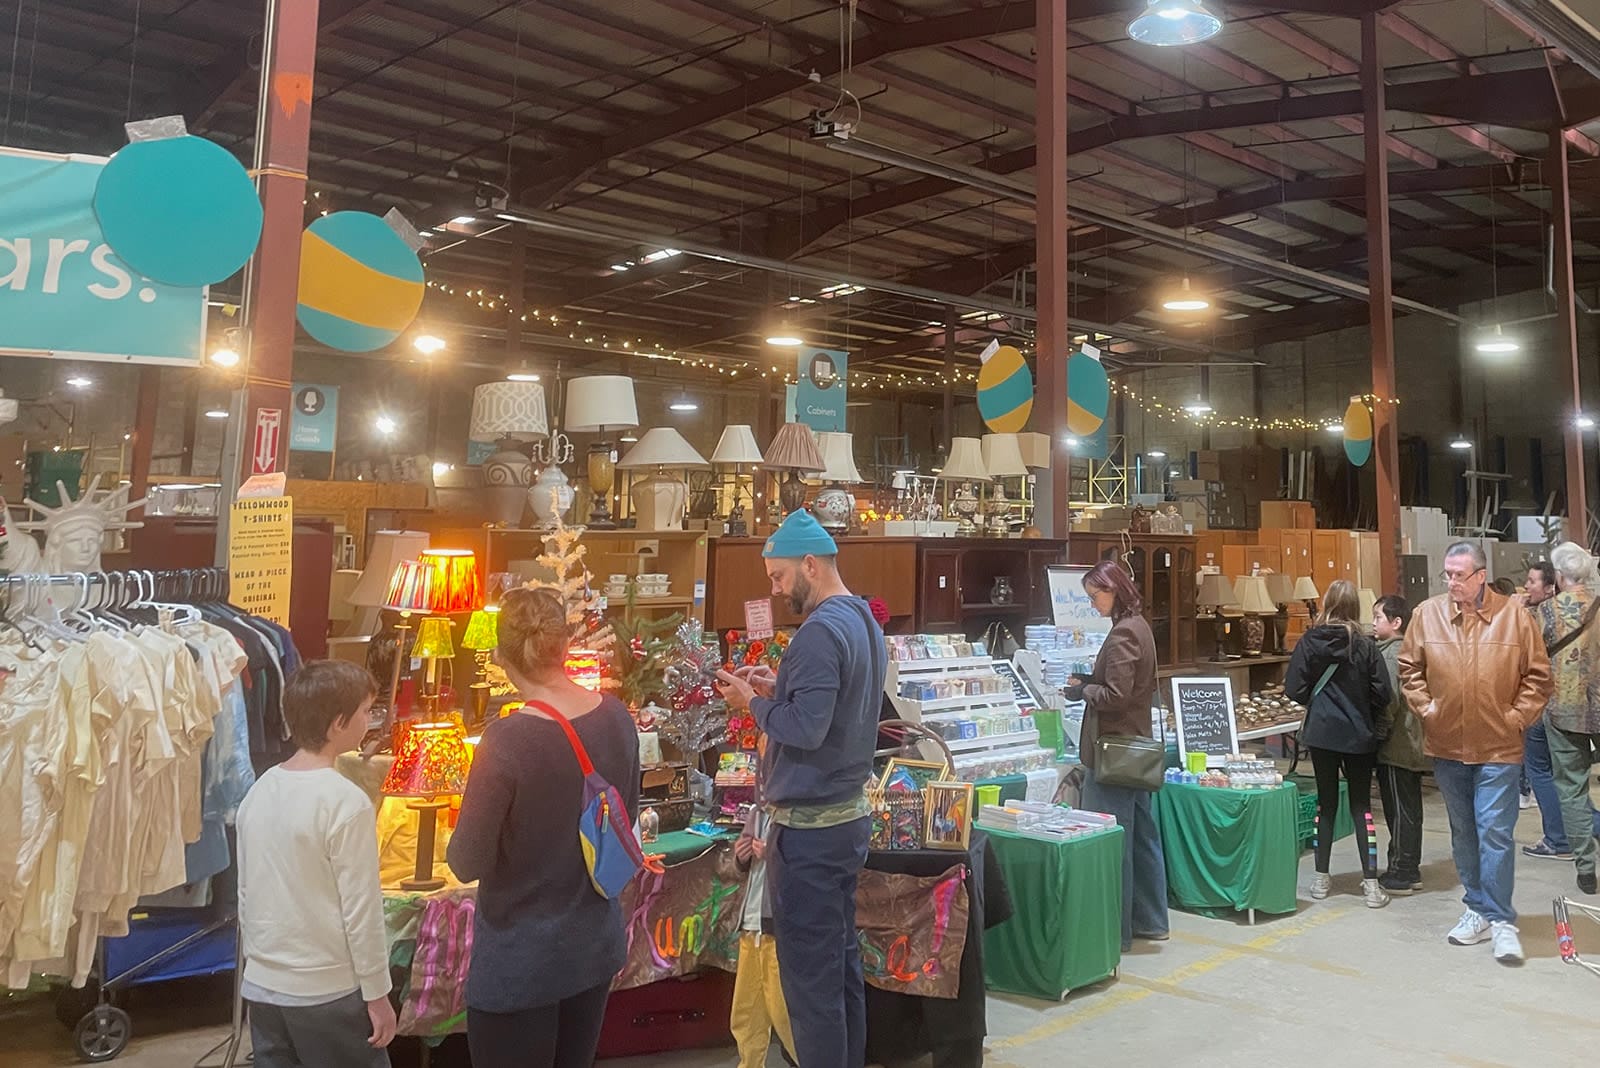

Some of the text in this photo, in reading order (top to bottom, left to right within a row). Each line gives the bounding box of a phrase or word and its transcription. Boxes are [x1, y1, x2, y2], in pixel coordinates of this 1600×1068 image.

[806, 405, 837, 417] Cabinets
[233, 500, 289, 510] YELLOWWOOD
[243, 513, 282, 523] T-SHIRTS
[246, 581, 271, 590] OF THE
[1181, 689, 1223, 699] Welcome
